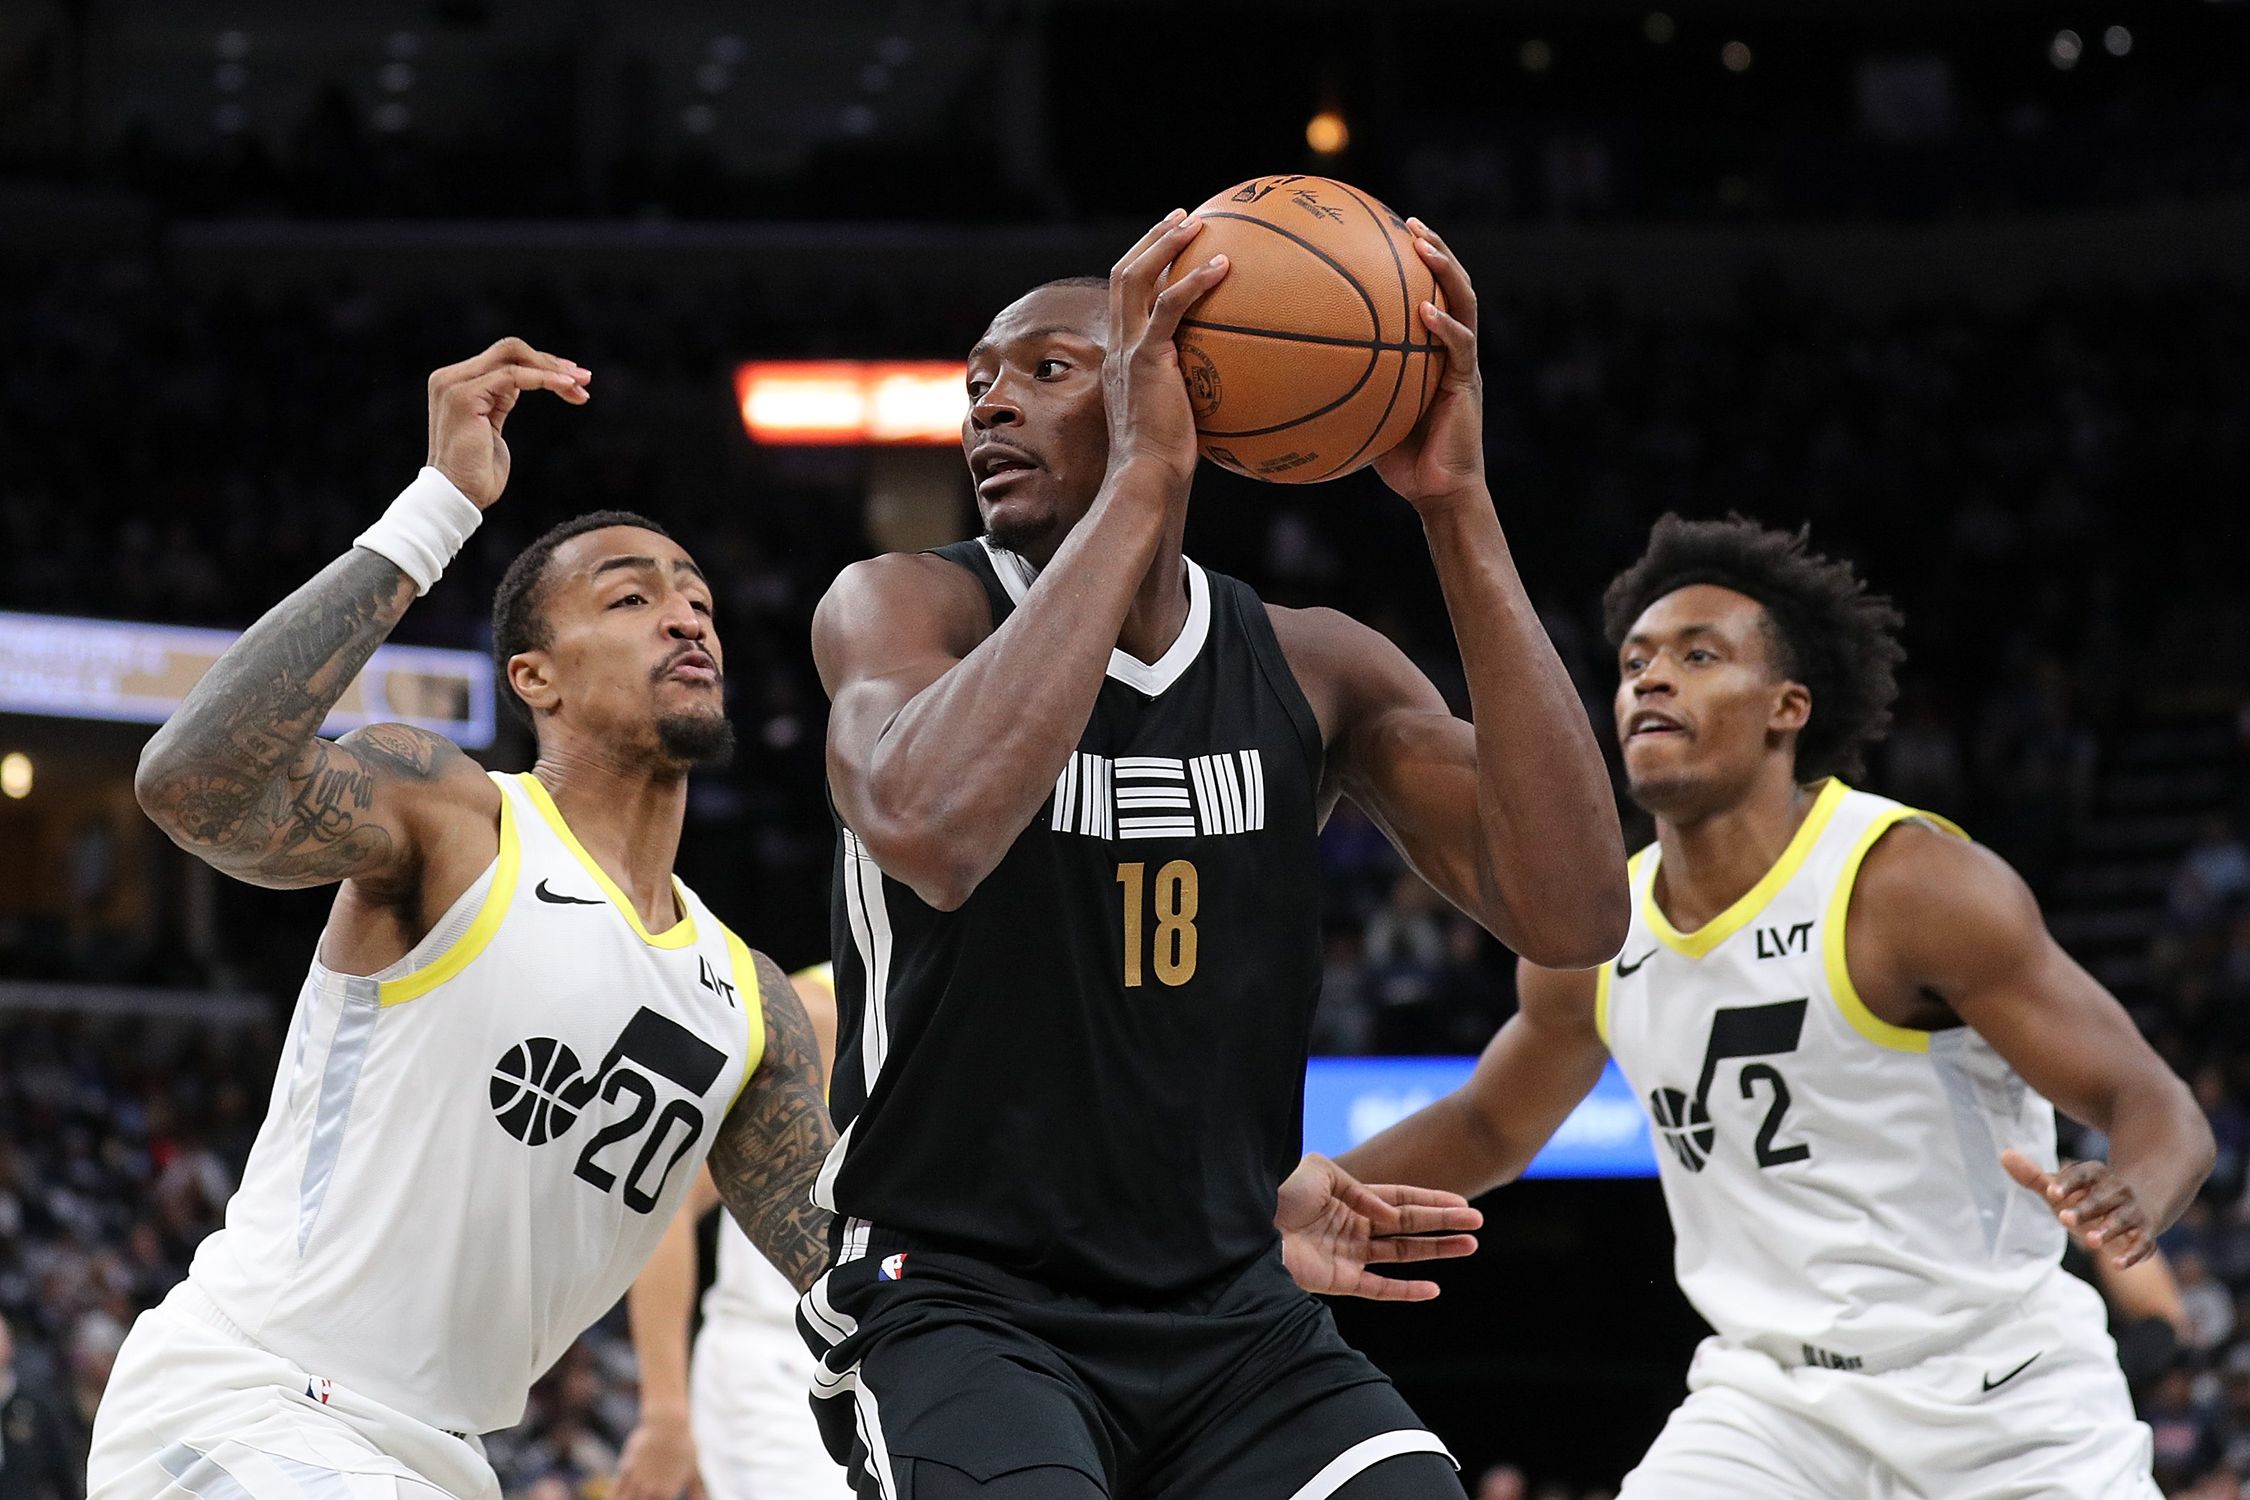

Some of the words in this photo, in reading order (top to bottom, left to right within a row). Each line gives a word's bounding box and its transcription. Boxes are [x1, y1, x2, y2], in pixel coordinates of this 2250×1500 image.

[1115, 859, 1199, 988] 18
[1756, 919, 1816, 960] LVT
[572, 1067, 704, 1214] 20
[1739, 1062, 1811, 1169] 2
